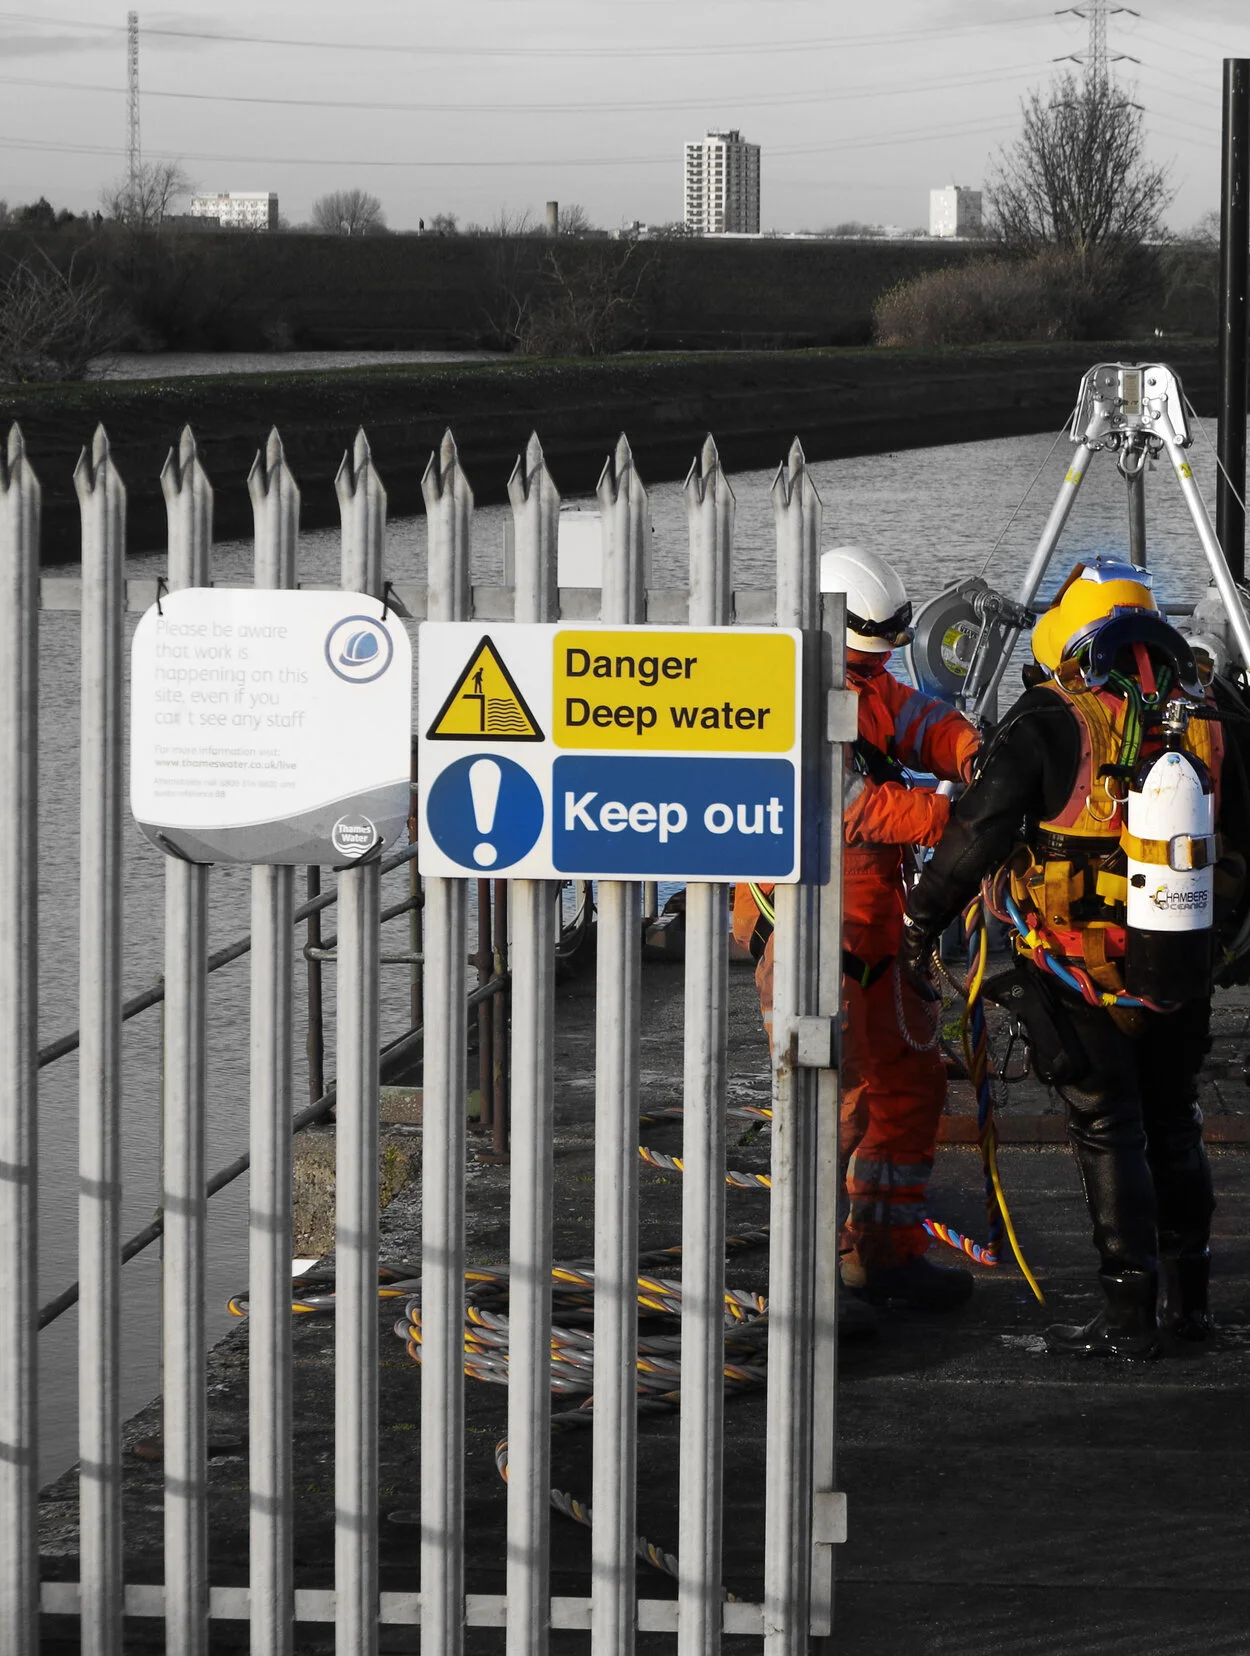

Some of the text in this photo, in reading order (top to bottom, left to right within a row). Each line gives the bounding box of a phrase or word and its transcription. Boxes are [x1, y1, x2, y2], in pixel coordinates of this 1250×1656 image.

[156, 619, 288, 639] Please be aware
[155, 642, 249, 660] that work is
[154, 664, 309, 686] happening on this
[565, 648, 697, 687] Danger
[190, 689, 228, 704] even
[234, 688, 246, 704] if
[249, 691, 280, 709] you
[199, 712, 228, 726] see
[231, 713, 261, 731] any
[266, 710, 306, 728] staff
[565, 697, 771, 736] Deep water
[199, 745, 256, 757] information
[154, 758, 297, 770] www.thameswater.co.uk/live
[564, 791, 784, 844] Keep out
[338, 824, 371, 833] Thames
[341, 834, 368, 842] Water
[1155, 889, 1208, 903] CHAMBERS
